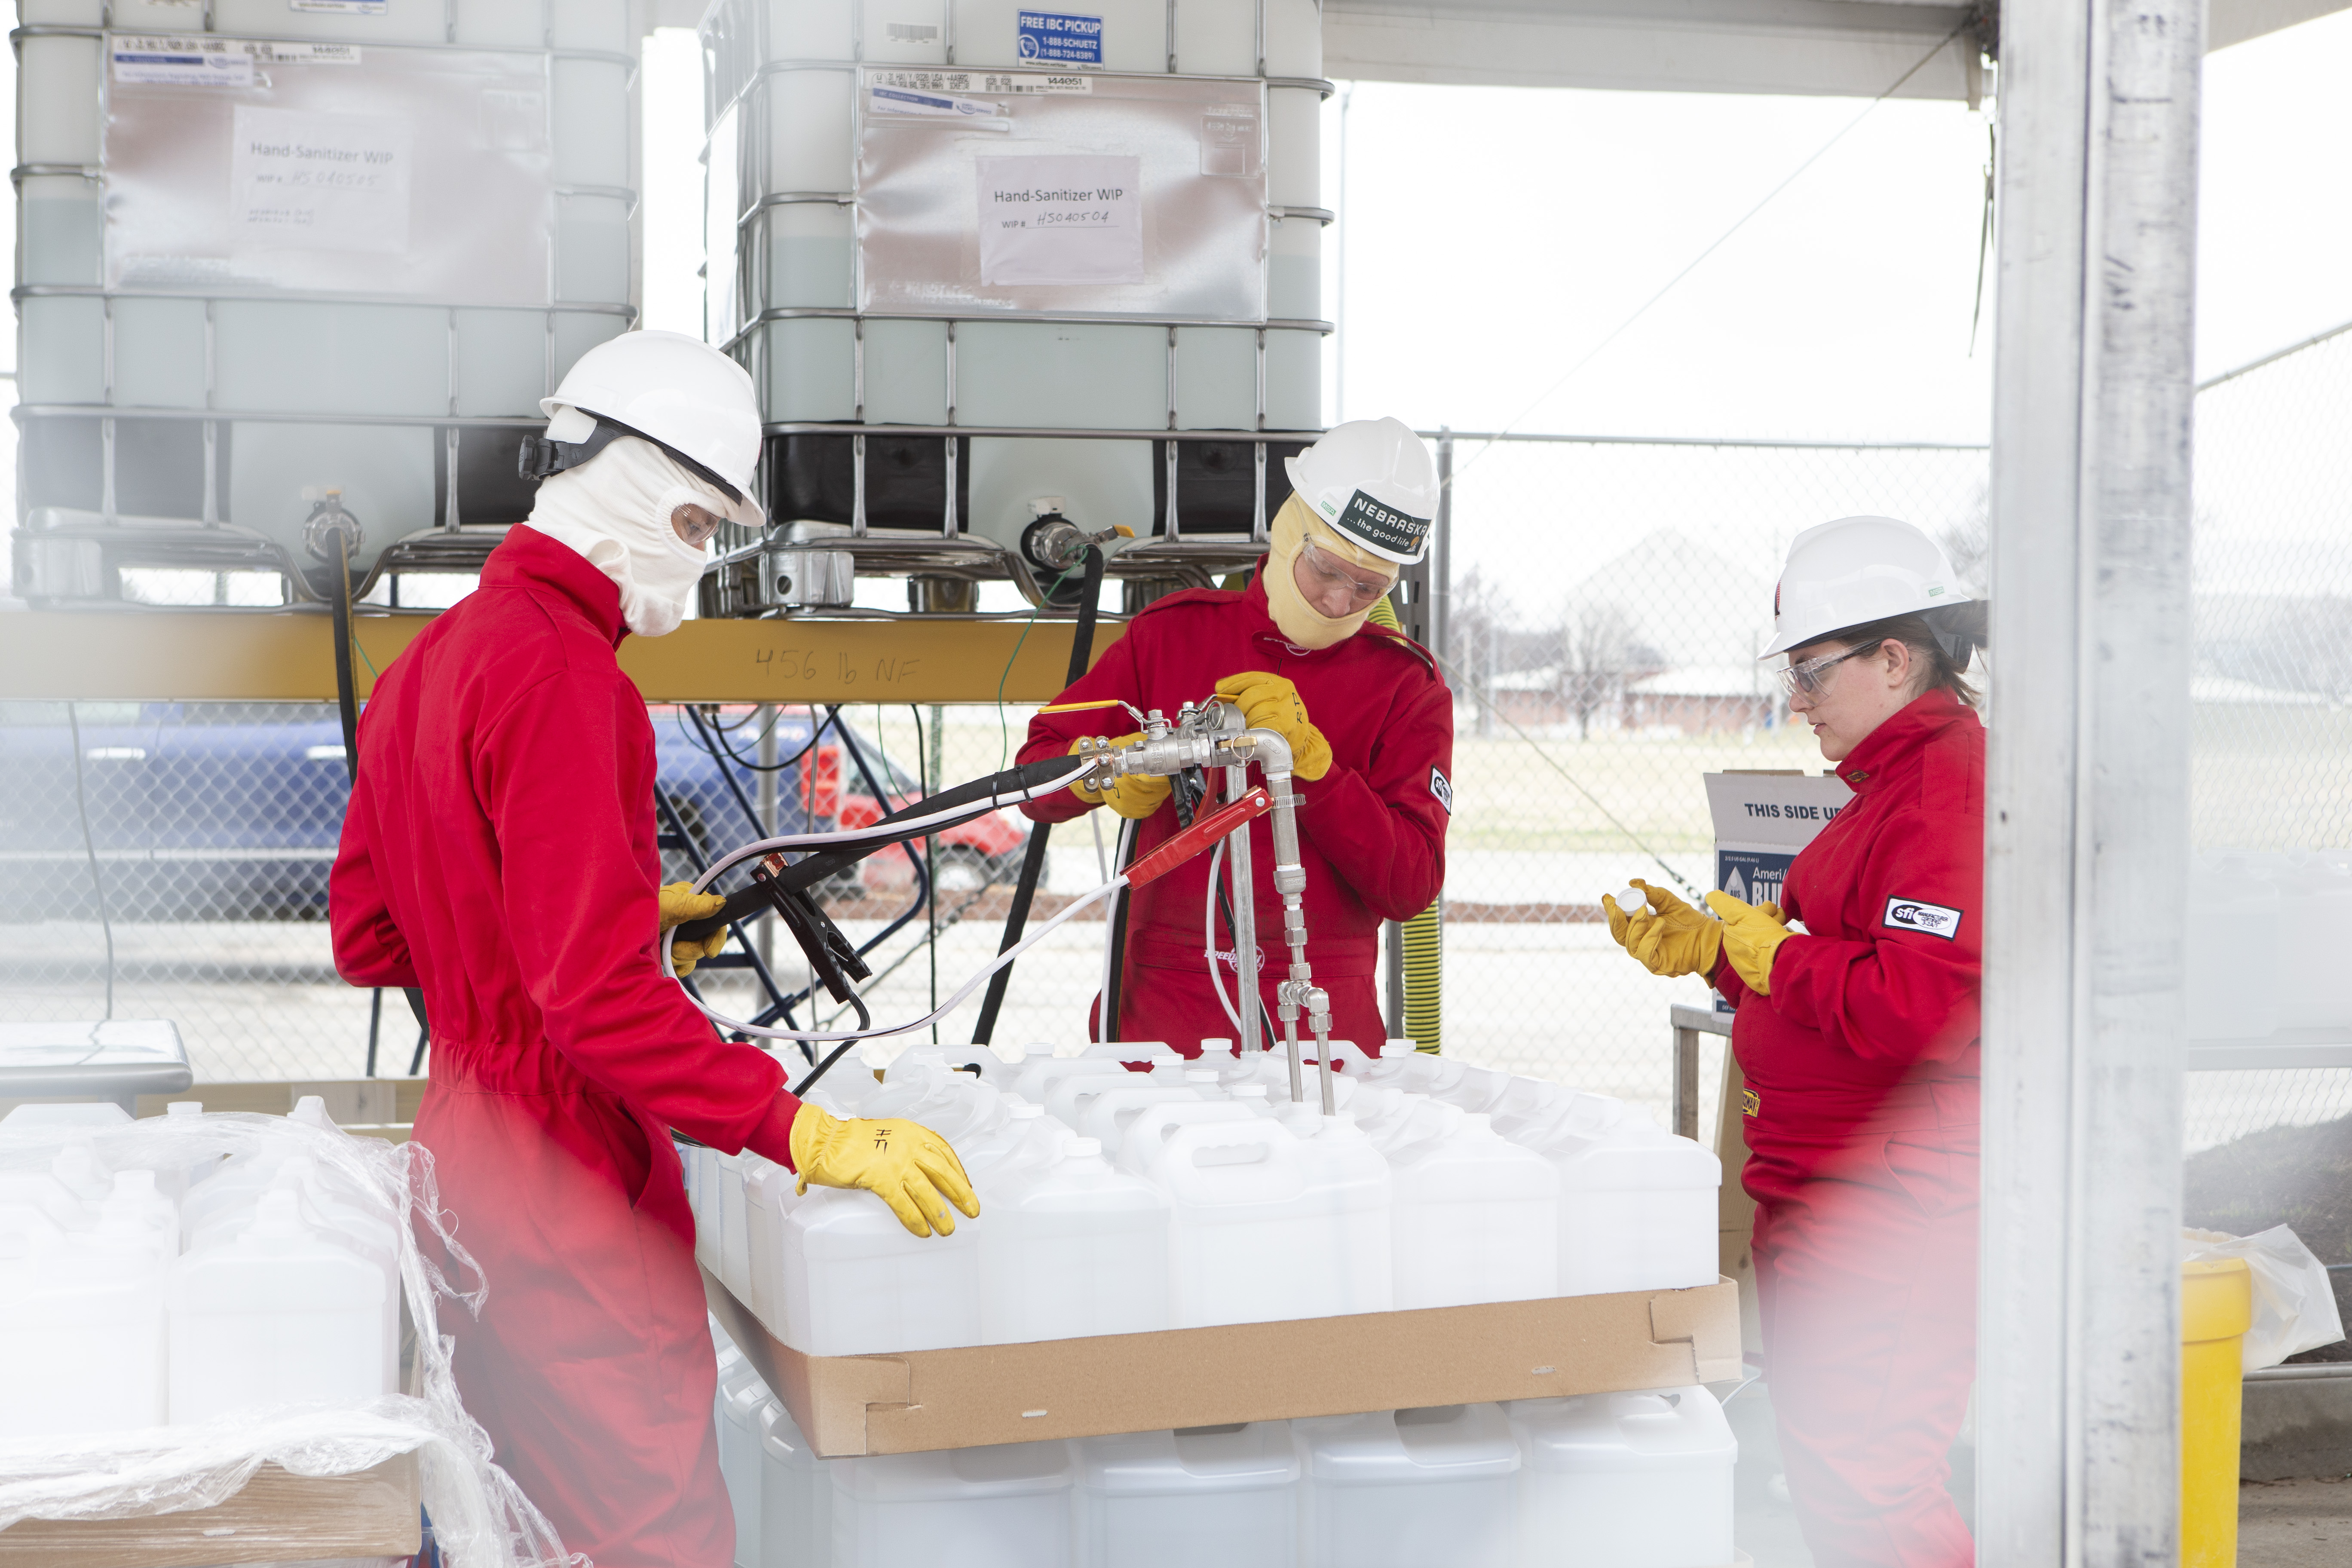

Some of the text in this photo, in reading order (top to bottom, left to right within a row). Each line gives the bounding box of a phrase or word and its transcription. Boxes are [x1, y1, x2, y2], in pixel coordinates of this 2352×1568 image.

[1020, 16, 1101, 34] FREE IBC PICKUP
[1042, 36, 1098, 49] 1-888-SCHUETZ
[1040, 48, 1095, 61] (1-888-724-8389)
[251, 141, 394, 165] Hand-Sanitizer WIP
[994, 189, 1123, 202] Hand-Sanitizer WIP
[1037, 211, 1109, 225] HS040504
[1321, 501, 1336, 515] MSA
[1354, 498, 1427, 536] NEBRASKA
[1372, 529, 1398, 543] good
[1397, 536, 1409, 547] life
[1929, 587, 1944, 597] MSA
[756, 649, 921, 684] 456 lb NF
[1744, 803, 1780, 818] THIS
[1784, 805, 1820, 820] SIDE
[1730, 890, 1741, 898] AUS
[1896, 907, 1915, 920] sfi
[1918, 911, 1949, 922] MANUFACTURER
